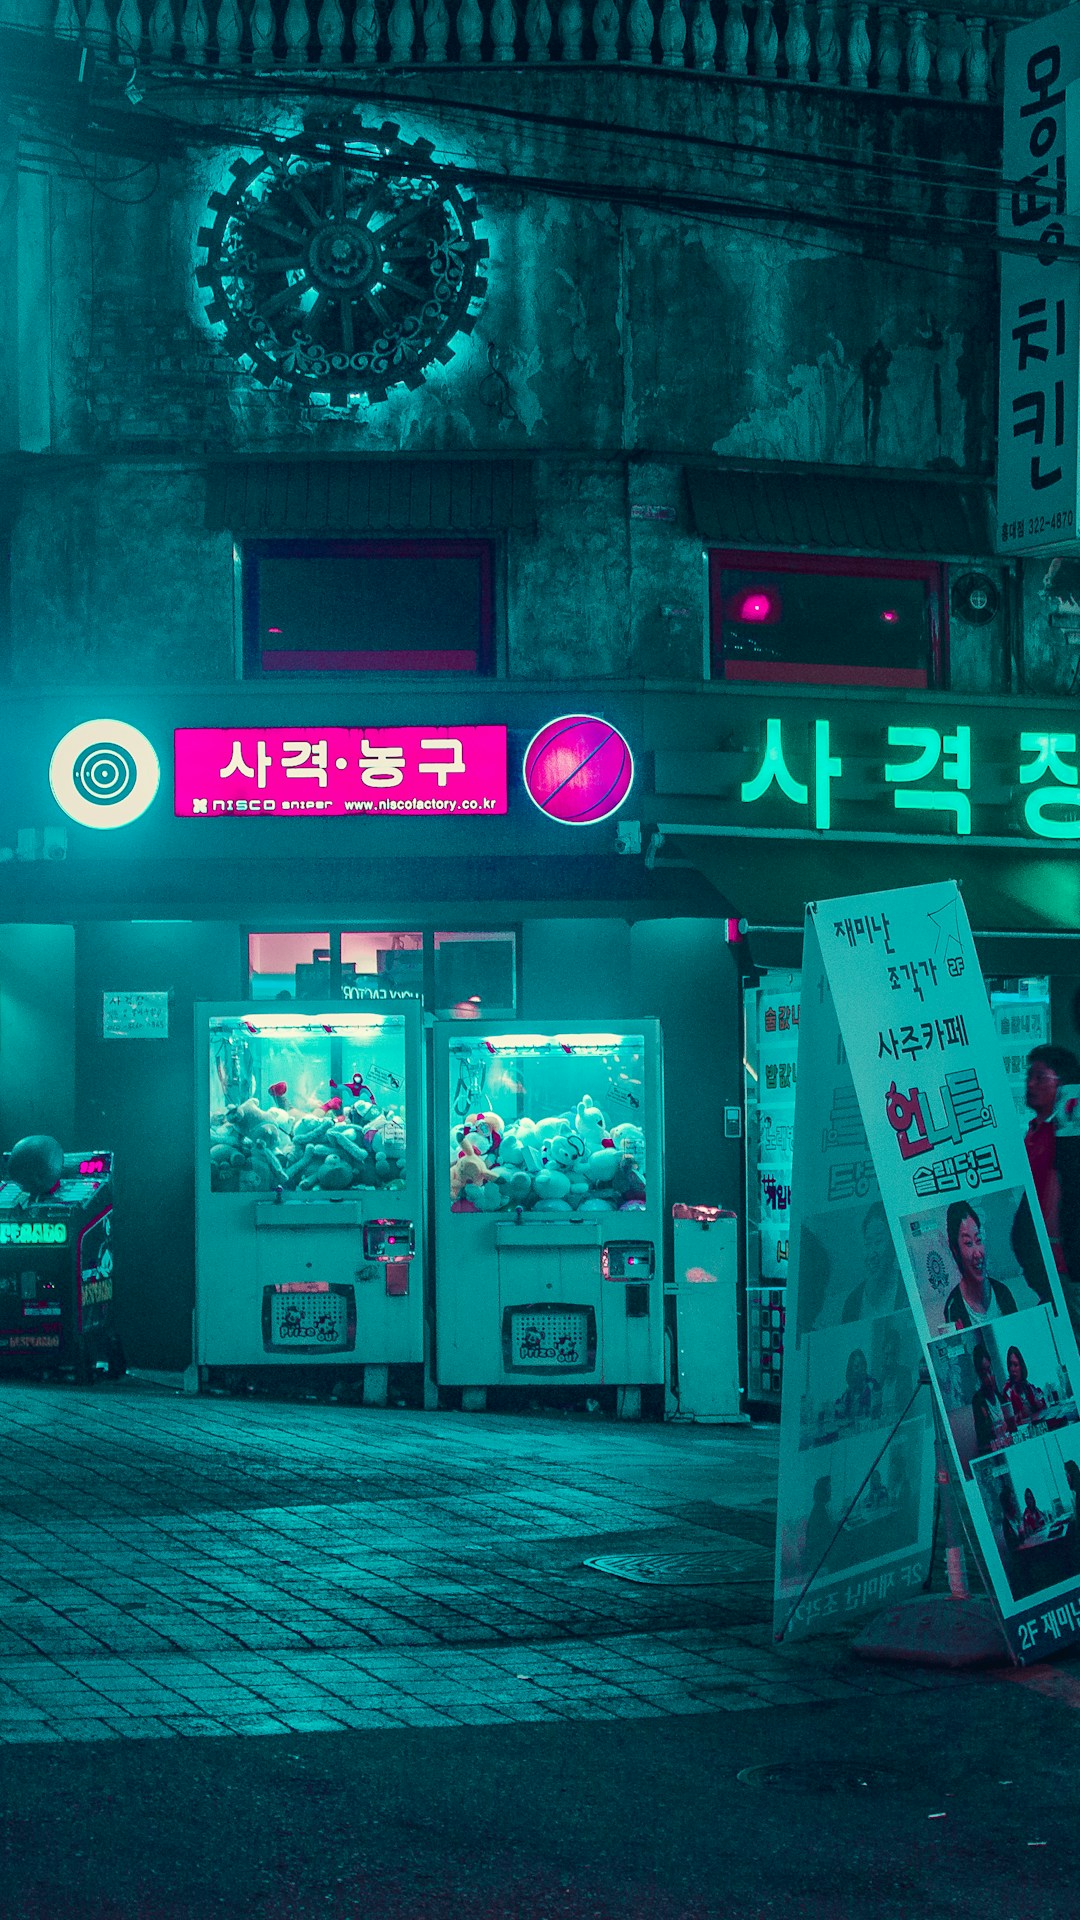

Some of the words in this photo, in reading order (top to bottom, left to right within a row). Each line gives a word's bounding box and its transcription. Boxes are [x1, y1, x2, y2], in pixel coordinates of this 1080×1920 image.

[1012, 298, 1066, 491] 치킨
[1028, 510, 1074, 534] 322-4870
[344, 798, 496, 812] www.niscofactory.co.kr
[833, 912, 895, 955] 재미난
[887, 957, 937, 1002] 조각가
[877, 1014, 970, 1062] 사주카페
[912, 1143, 1003, 1197] 슬램덩크
[1017, 1618, 1039, 1651] 2F
